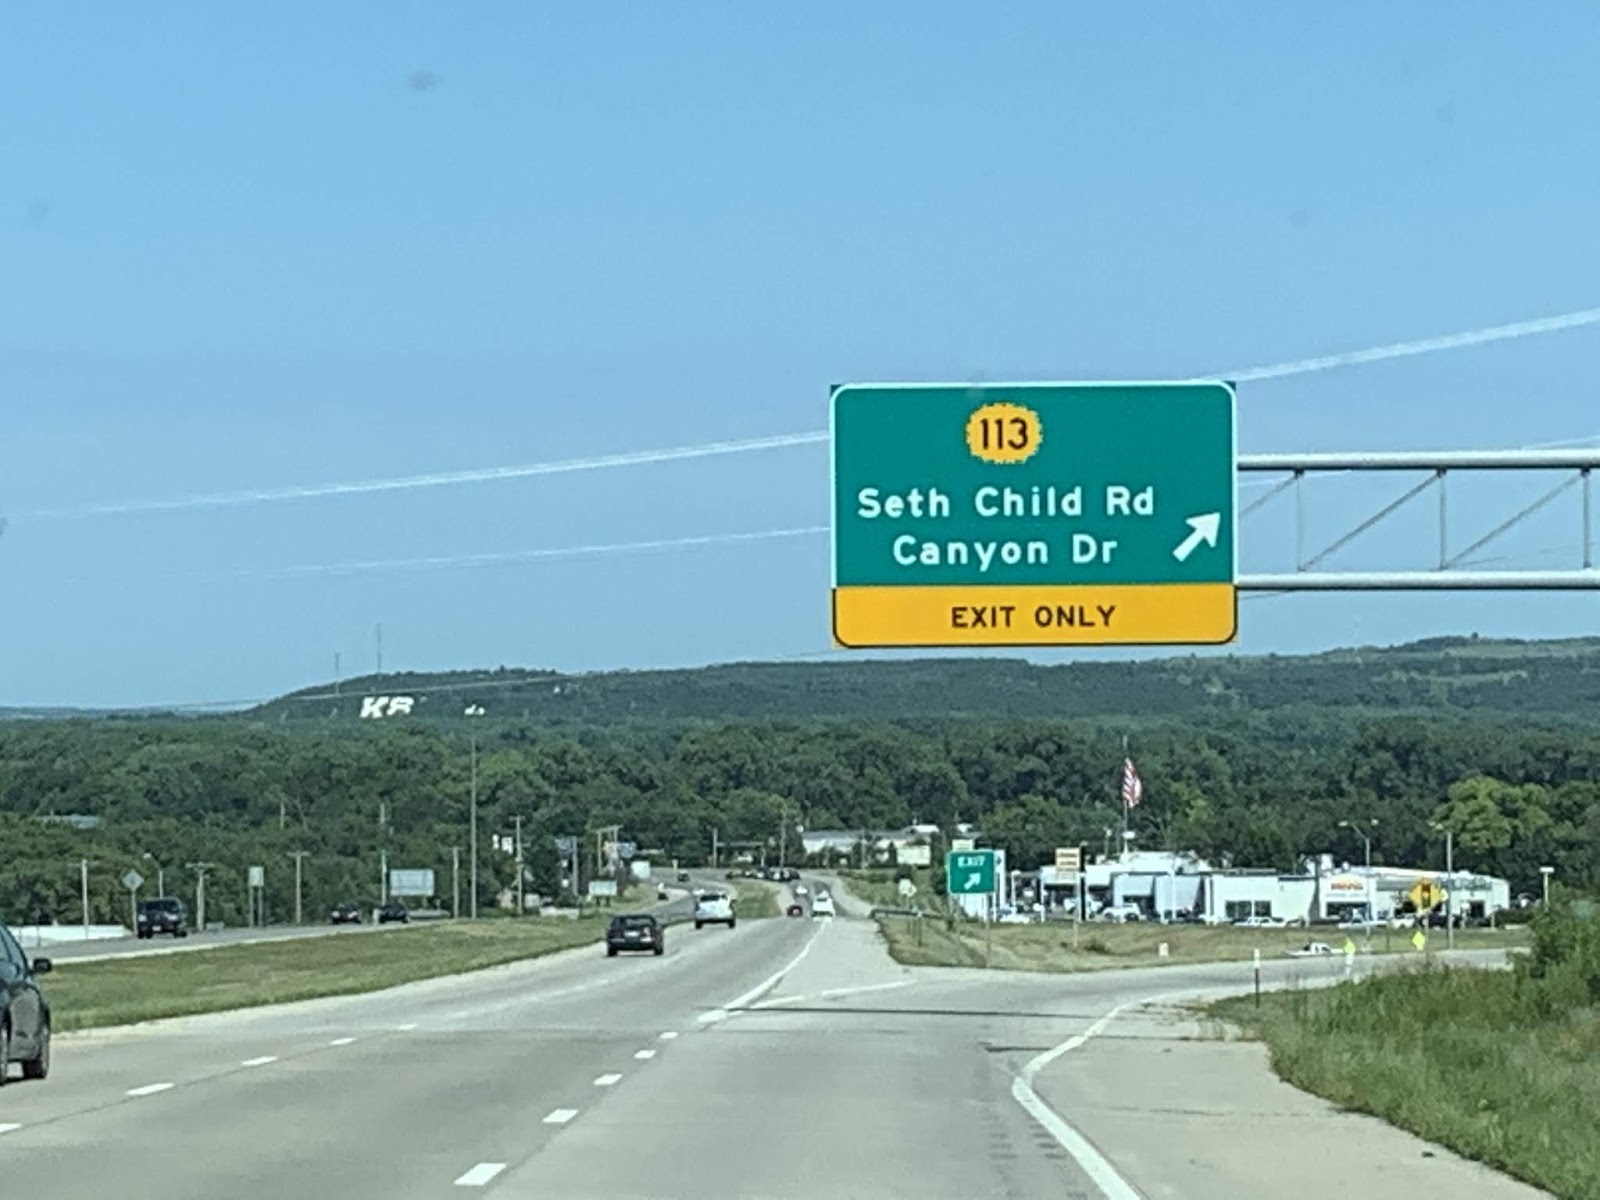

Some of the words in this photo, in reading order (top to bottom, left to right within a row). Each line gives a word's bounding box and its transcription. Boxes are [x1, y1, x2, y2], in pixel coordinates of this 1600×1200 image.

[980, 417, 1028, 450] 113
[858, 487, 949, 518] Seth
[975, 486, 1082, 516] Child
[1105, 486, 1154, 516] Rd
[893, 535, 1048, 572] Canyon
[1072, 533, 1118, 564] Dr
[951, 606, 1015, 629] EXIT
[1034, 605, 1116, 628] ONLY
